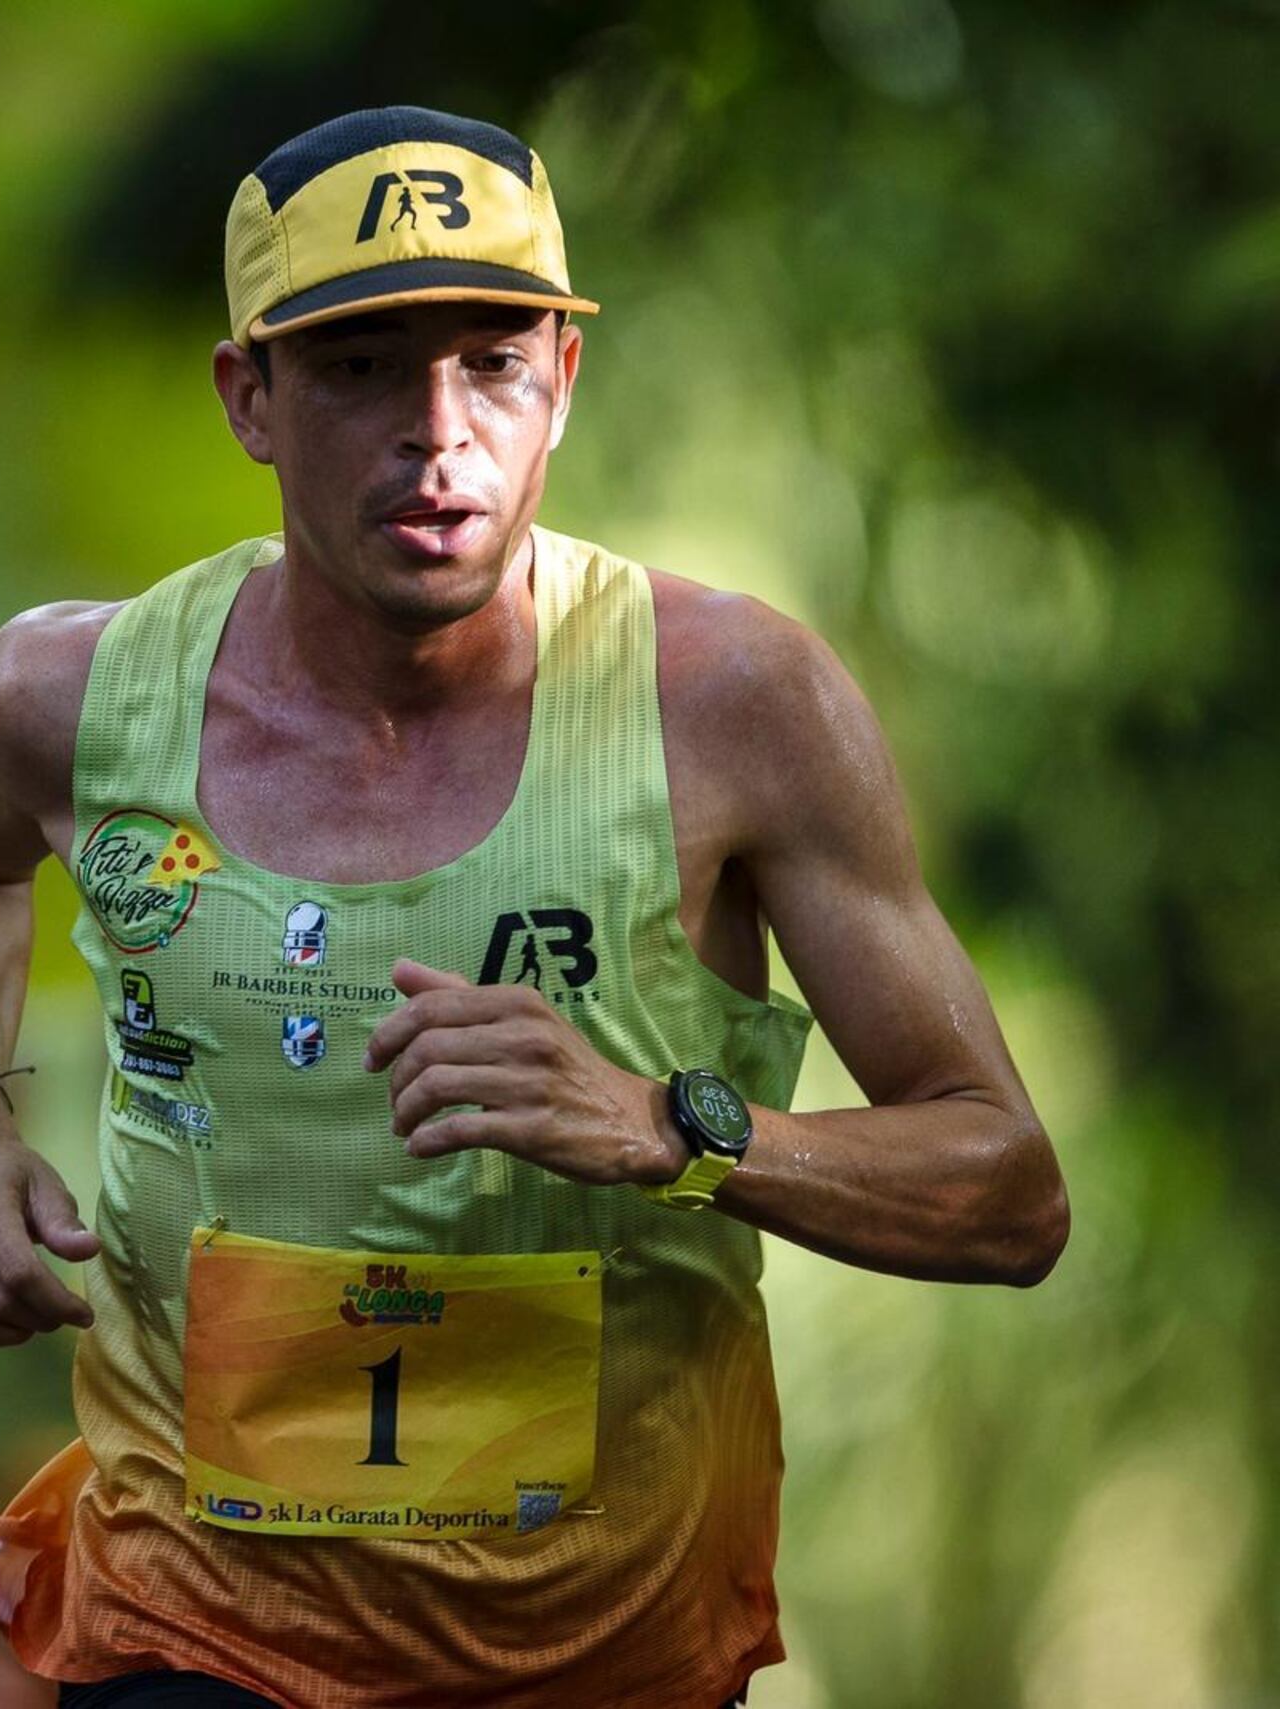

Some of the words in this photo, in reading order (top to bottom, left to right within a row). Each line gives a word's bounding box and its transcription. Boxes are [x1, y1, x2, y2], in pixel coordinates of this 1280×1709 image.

[213, 970, 232, 988] JR
[237, 974, 315, 997] BARBER
[319, 983, 397, 1002] STUDIO
[354, 1344, 410, 1467] 1
[268, 1504, 292, 1523] 5k
[297, 1504, 321, 1524] La
[326, 1506, 400, 1526] Garata
[404, 1506, 509, 1531] Deportiva
